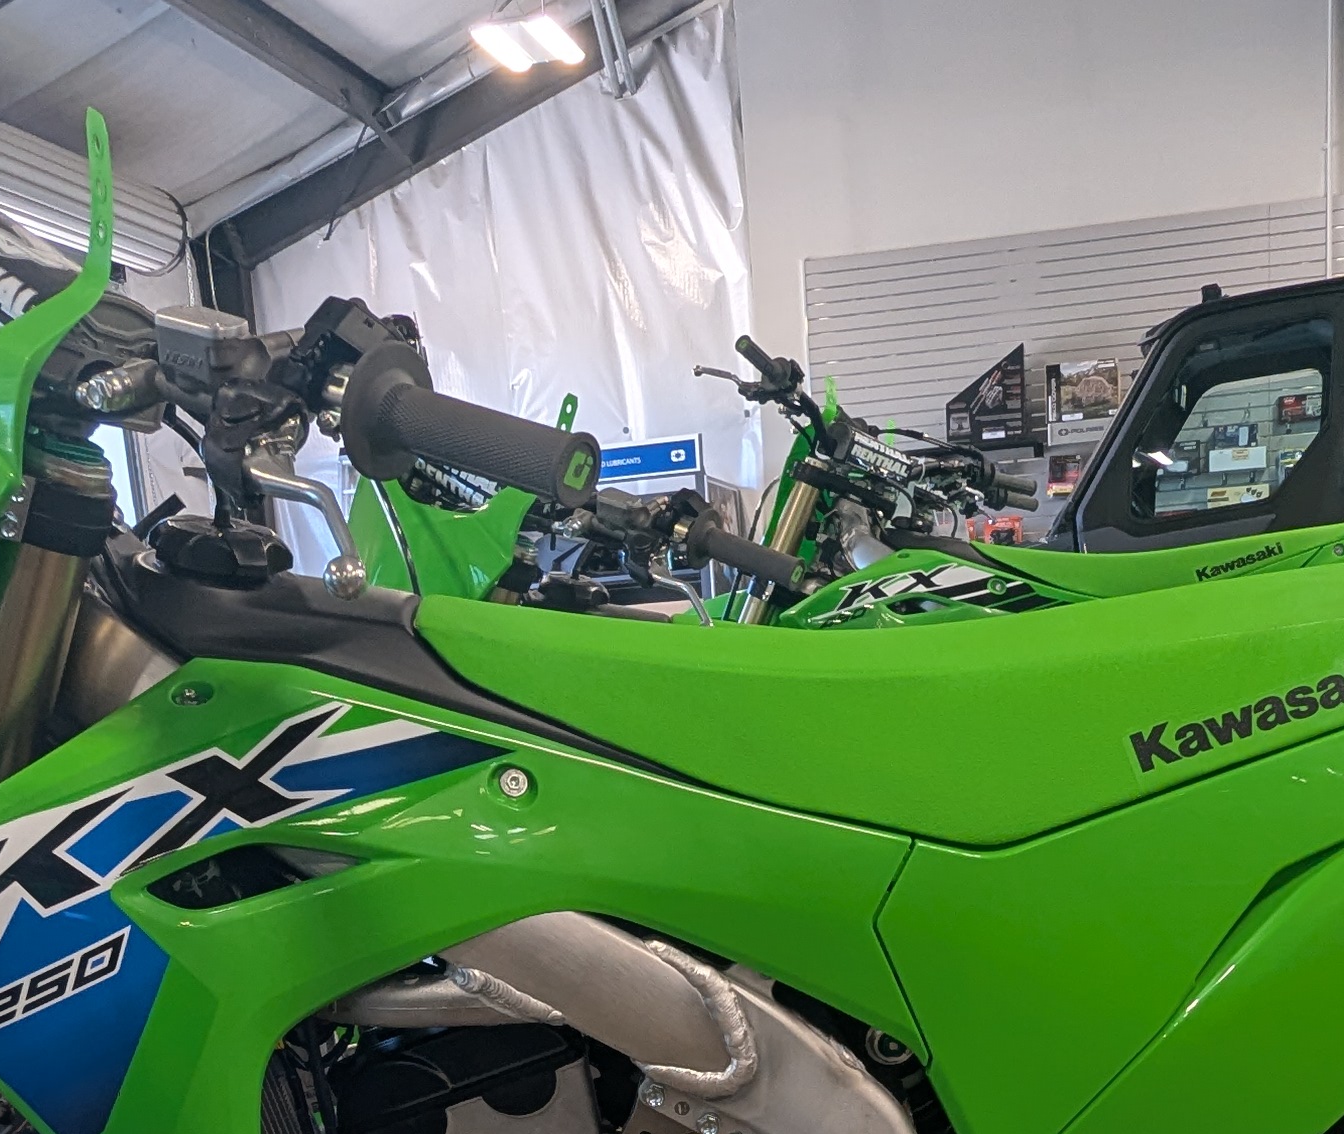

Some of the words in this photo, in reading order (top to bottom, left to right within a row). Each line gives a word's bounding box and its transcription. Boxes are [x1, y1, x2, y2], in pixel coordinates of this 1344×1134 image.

[606, 456, 642, 468] LUBRICANTS
[851, 443, 909, 478] RENTHAL
[1195, 542, 1284, 582] Kawasaki
